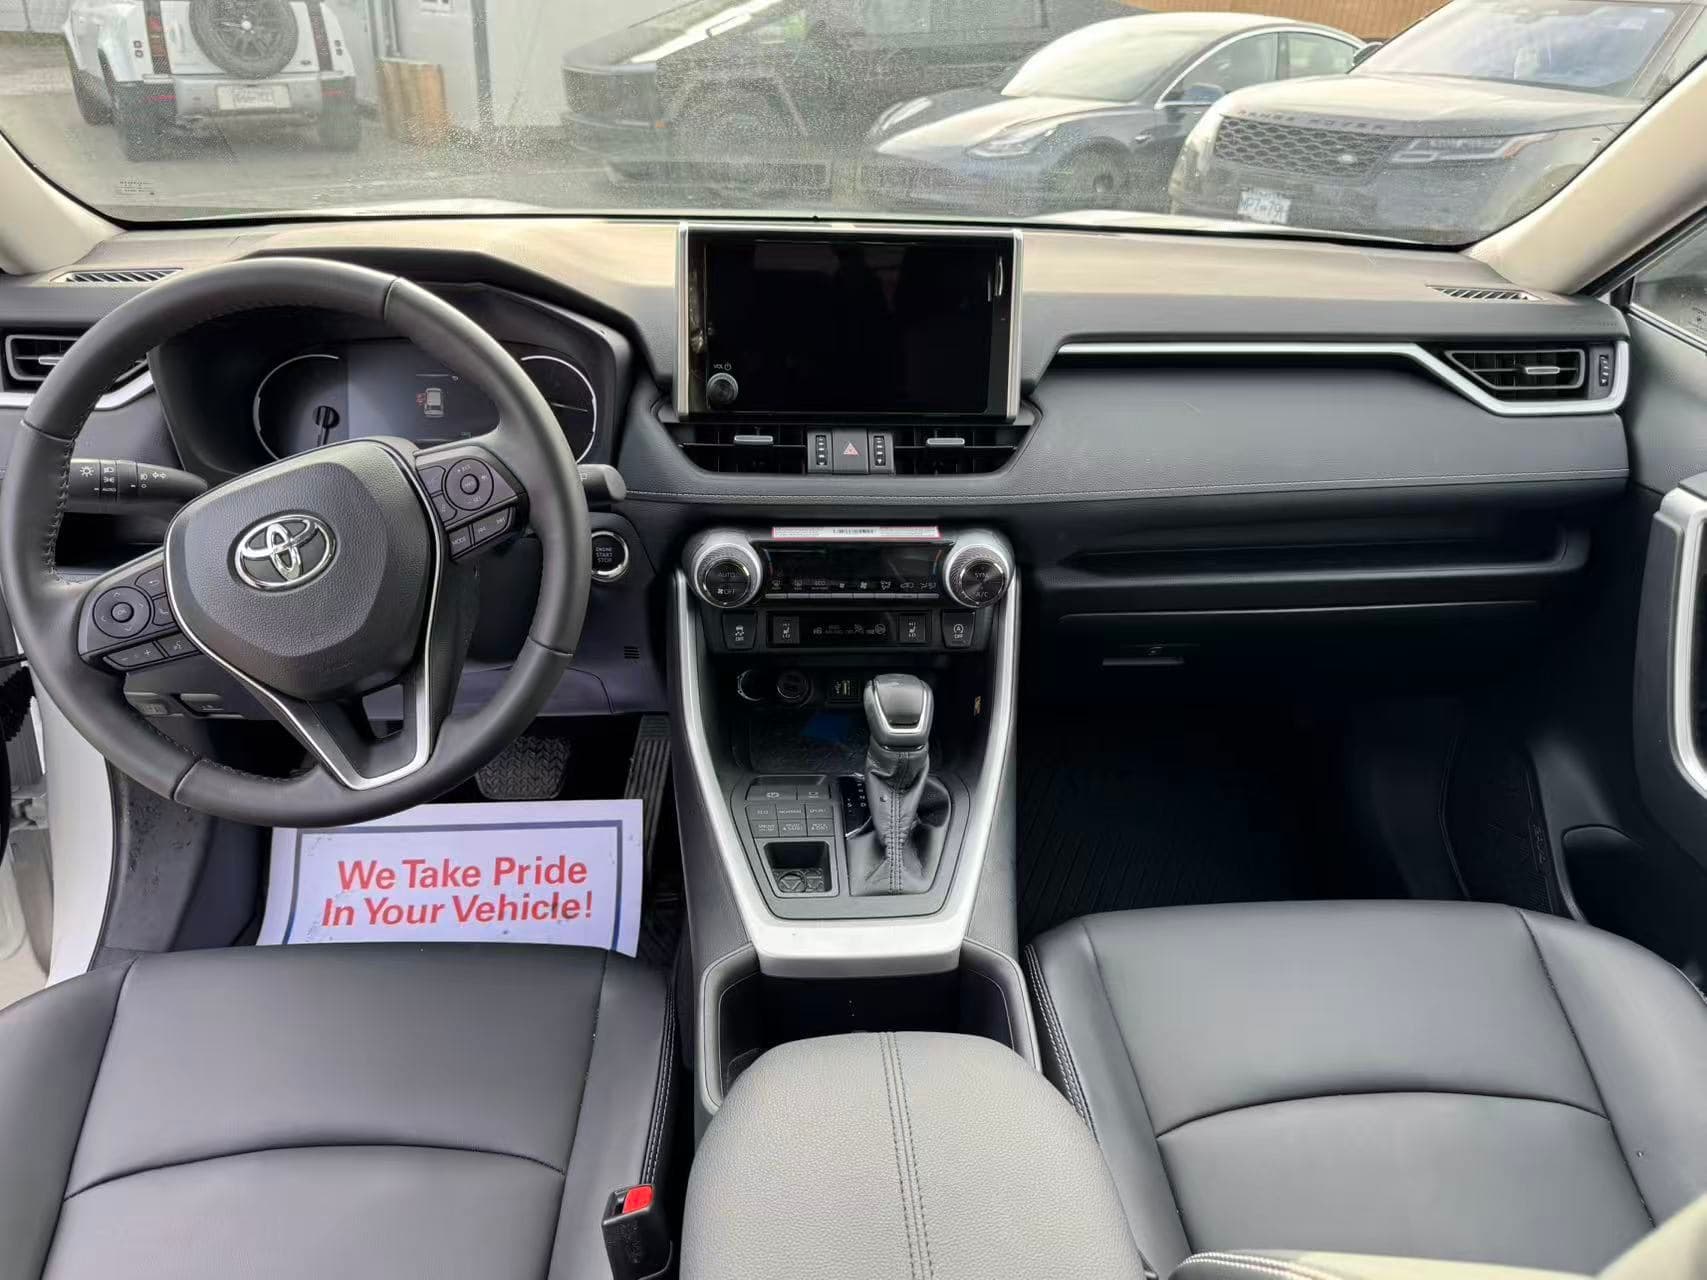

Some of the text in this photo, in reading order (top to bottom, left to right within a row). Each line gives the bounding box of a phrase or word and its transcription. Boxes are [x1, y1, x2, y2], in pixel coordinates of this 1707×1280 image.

[338, 855, 588, 891] We Take Pride
[321, 889, 594, 928] In Your Vehicle!
